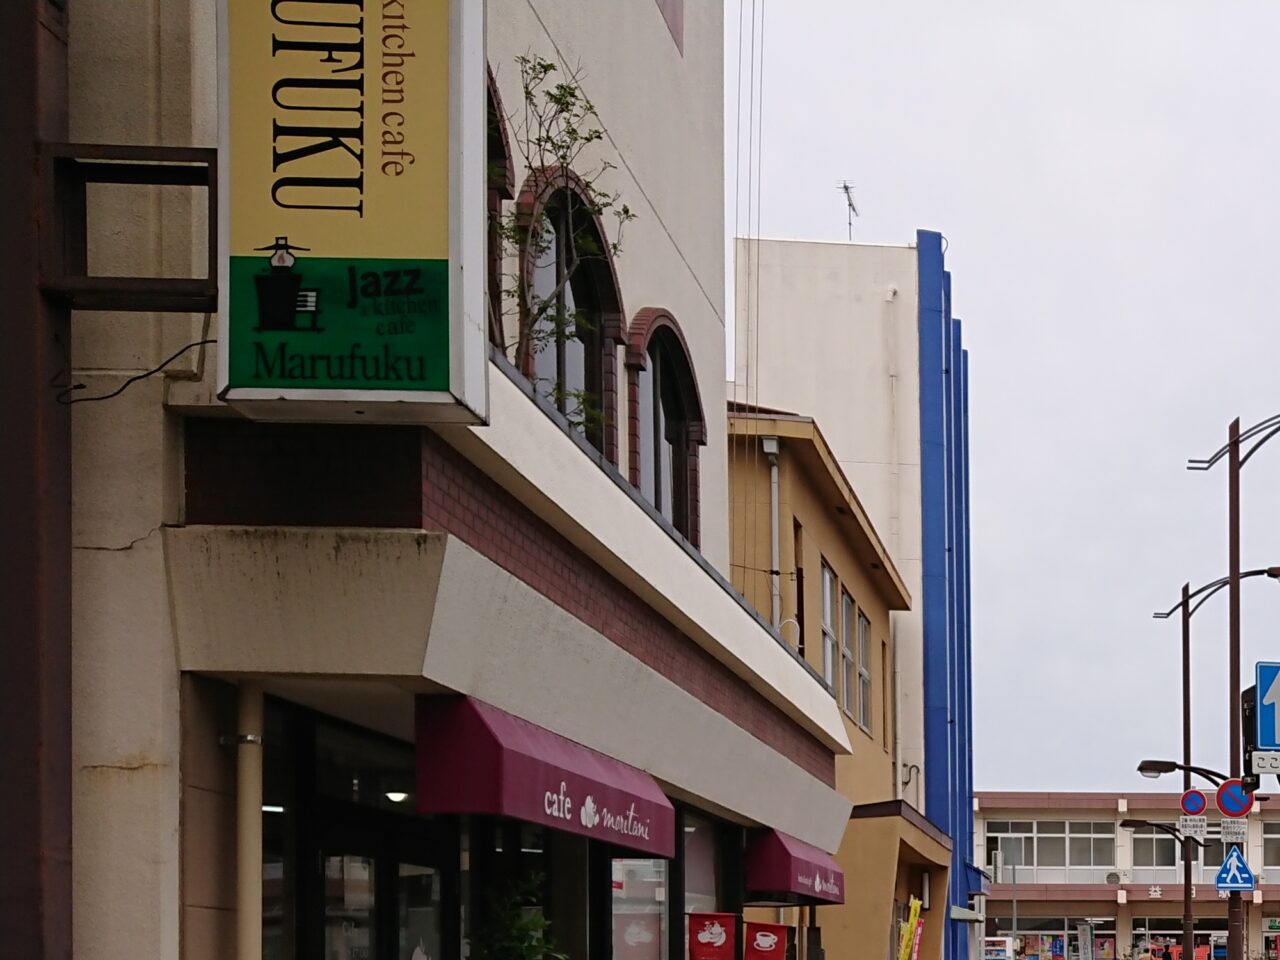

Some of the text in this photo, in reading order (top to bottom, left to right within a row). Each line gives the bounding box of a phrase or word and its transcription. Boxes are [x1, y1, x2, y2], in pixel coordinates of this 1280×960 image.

[381, 111, 416, 177] cafe
[374, 295, 438, 316] kitchen
[375, 317, 415, 336] cafe
[252, 341, 427, 381] Marufuku
[544, 781, 650, 840] cafe moritani
